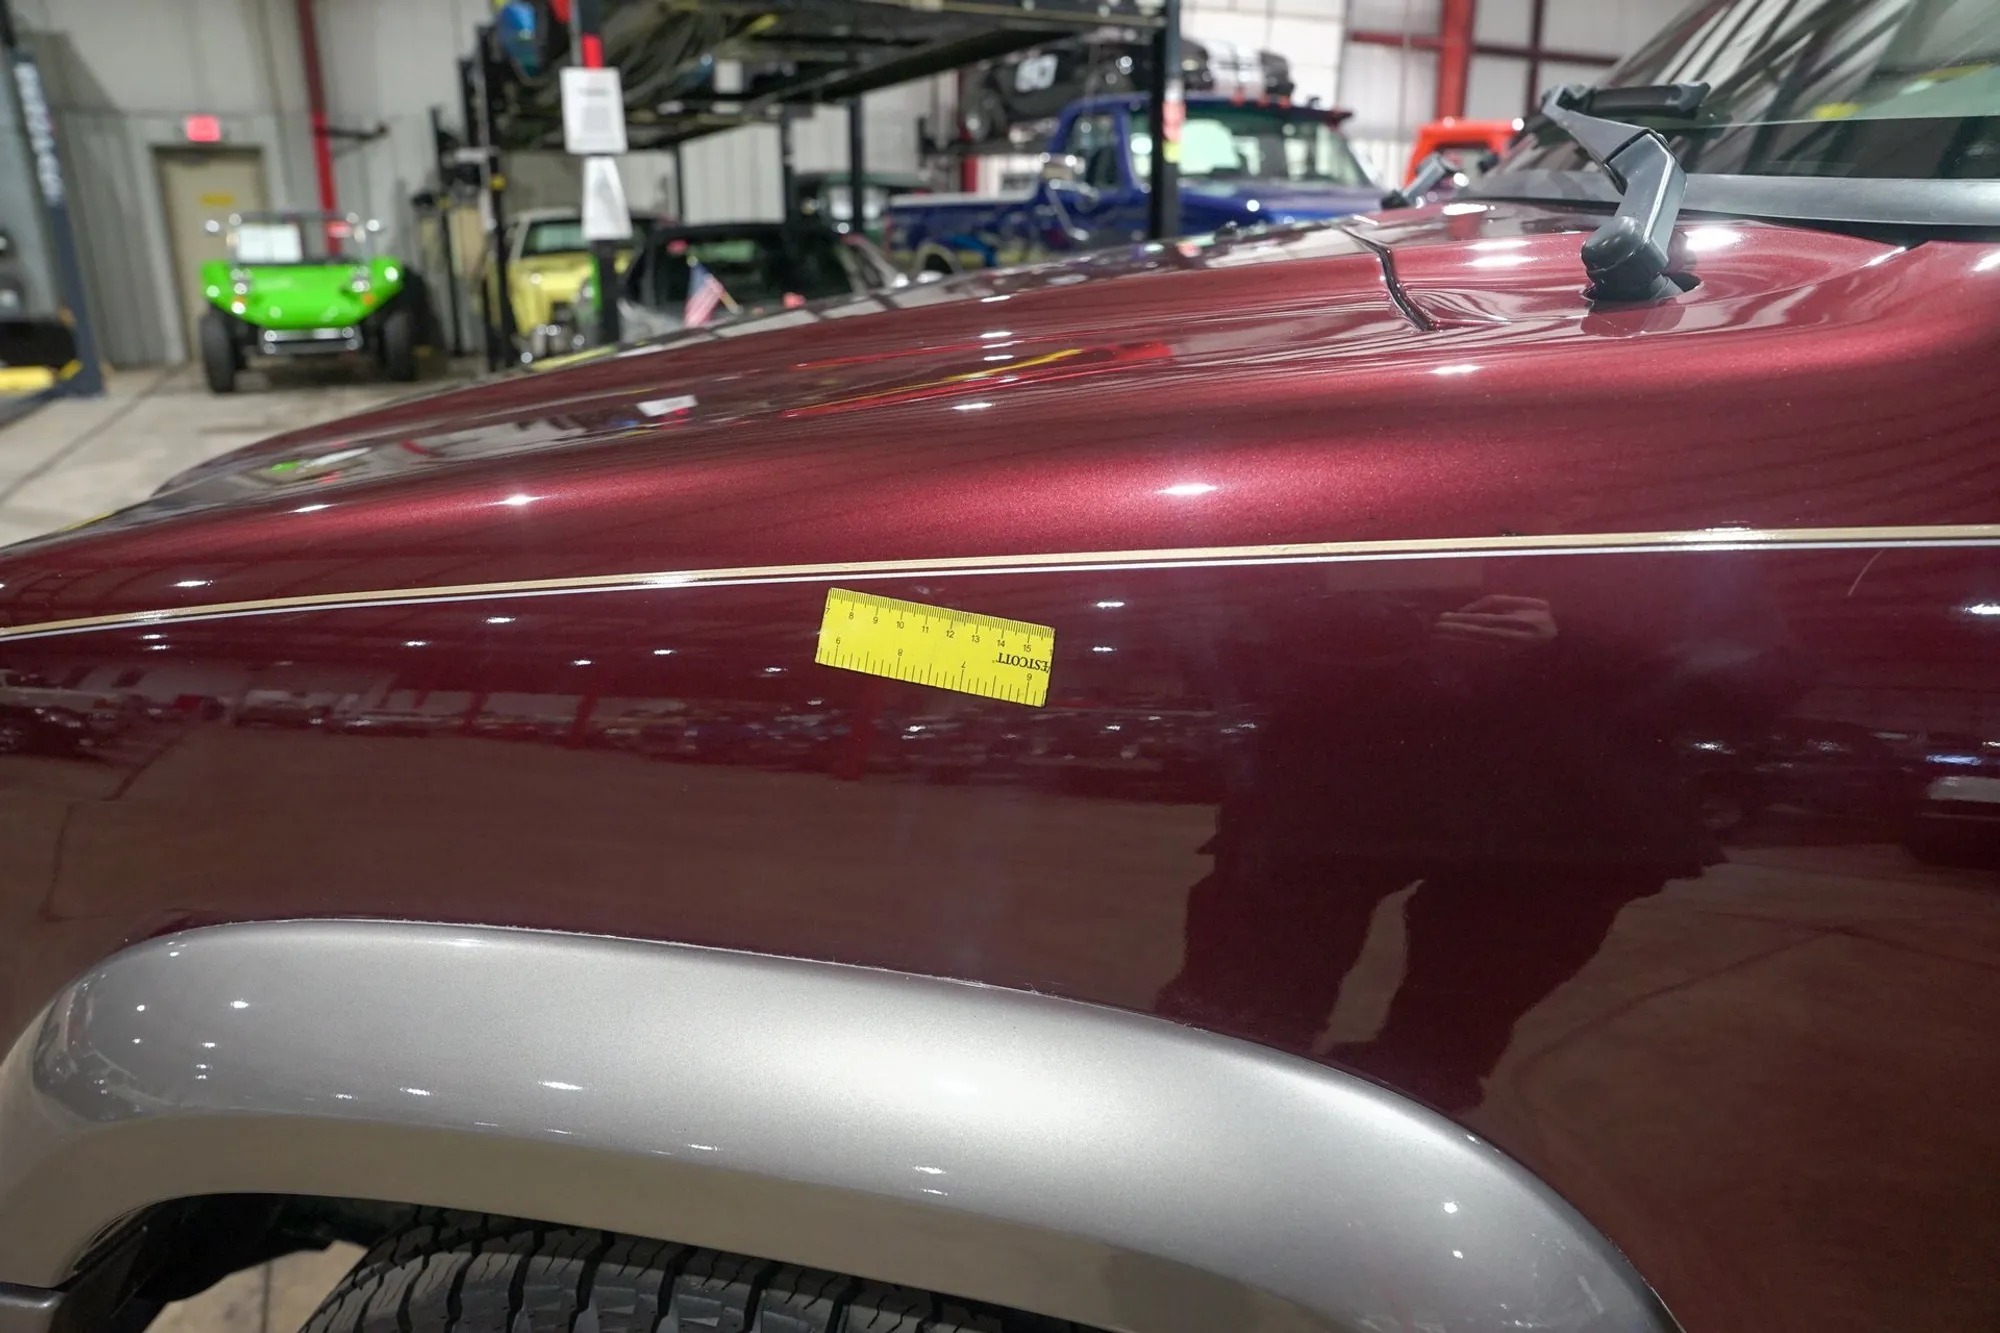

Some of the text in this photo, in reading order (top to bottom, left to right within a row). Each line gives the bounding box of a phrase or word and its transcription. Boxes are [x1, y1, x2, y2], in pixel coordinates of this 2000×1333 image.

[849, 612, 854, 620] 8
[897, 621, 905, 629] 10
[922, 626, 929, 634] 11
[946, 631, 955, 639] 12
[972, 635, 980, 643] 13
[997, 639, 1005, 647] 14
[1023, 644, 1032, 653] 15
[898, 649, 903, 657] 8
[996, 652, 1051, 673] ESTCOTT
